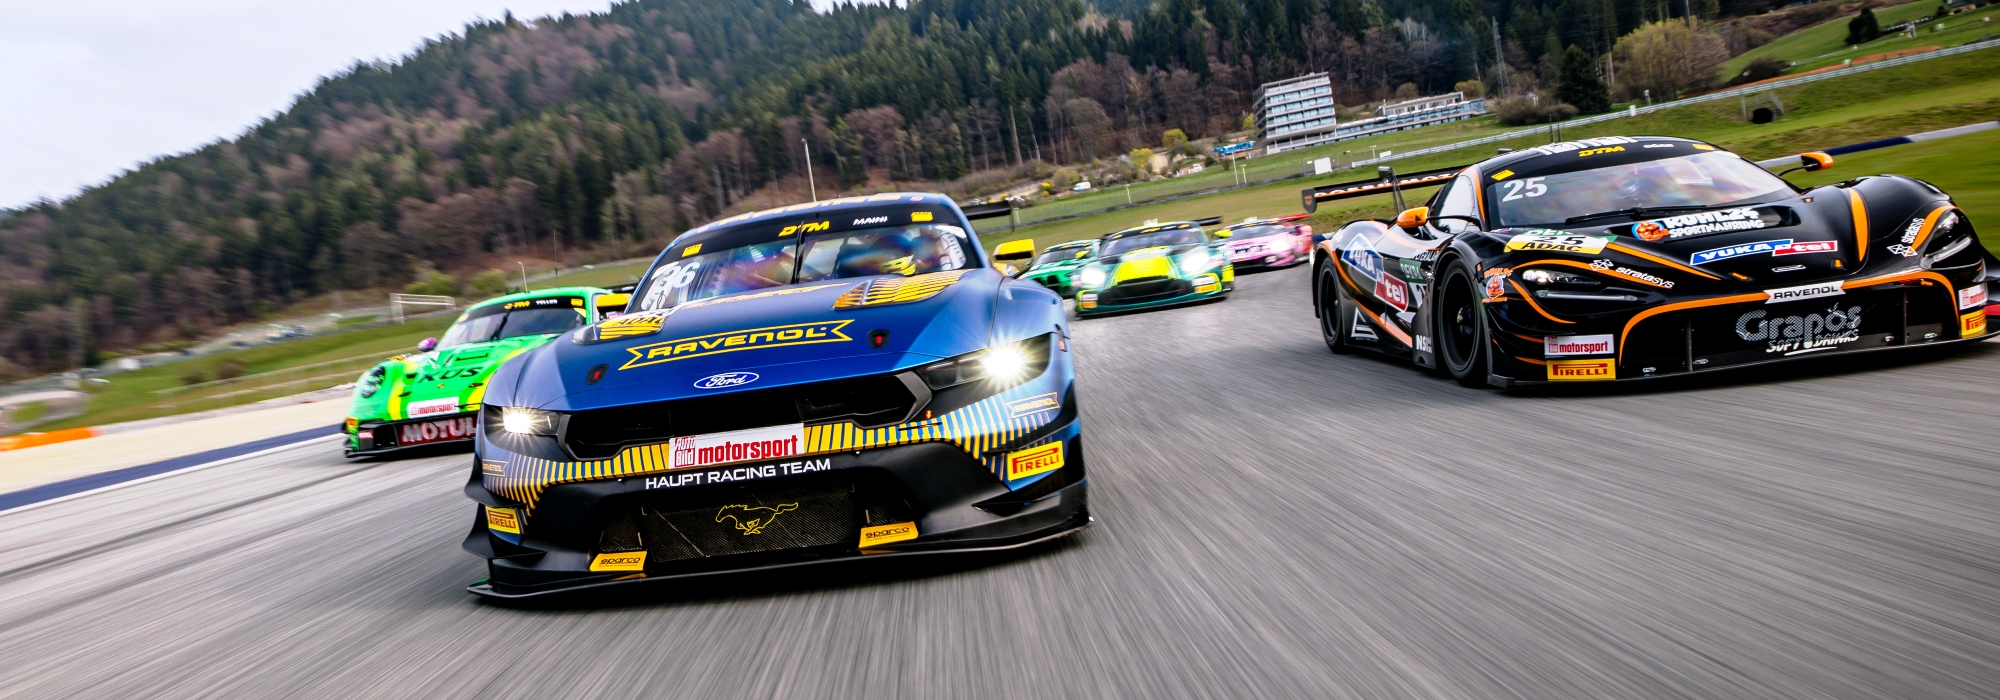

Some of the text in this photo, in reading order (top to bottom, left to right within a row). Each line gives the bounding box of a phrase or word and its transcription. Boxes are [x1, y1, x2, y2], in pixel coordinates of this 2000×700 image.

[1578, 146, 1626, 158] DTM
[1502, 176, 1548, 203] 25
[778, 221, 830, 237] DTM
[1520, 241, 1583, 252] ADAC
[1532, 236, 1586, 246] 25
[1699, 243, 1772, 260] YUKA
[1615, 266, 1676, 289] stratasys
[1384, 279, 1406, 305] tel
[1774, 285, 1839, 300] RAVENOL
[646, 327, 827, 360] RAVENOL
[1559, 341, 1609, 354] motorsport
[1552, 363, 1609, 376] PIRELLI
[704, 372, 747, 387] Ford
[402, 417, 477, 443] MOTUL
[698, 434, 799, 465] motorsport
[1012, 447, 1060, 475] PIRELLI
[645, 458, 832, 490] HAUPT RACING TEAM
[488, 509, 517, 530] PIRELLI
[865, 526, 911, 539] sparco
[600, 557, 641, 565] sparco
